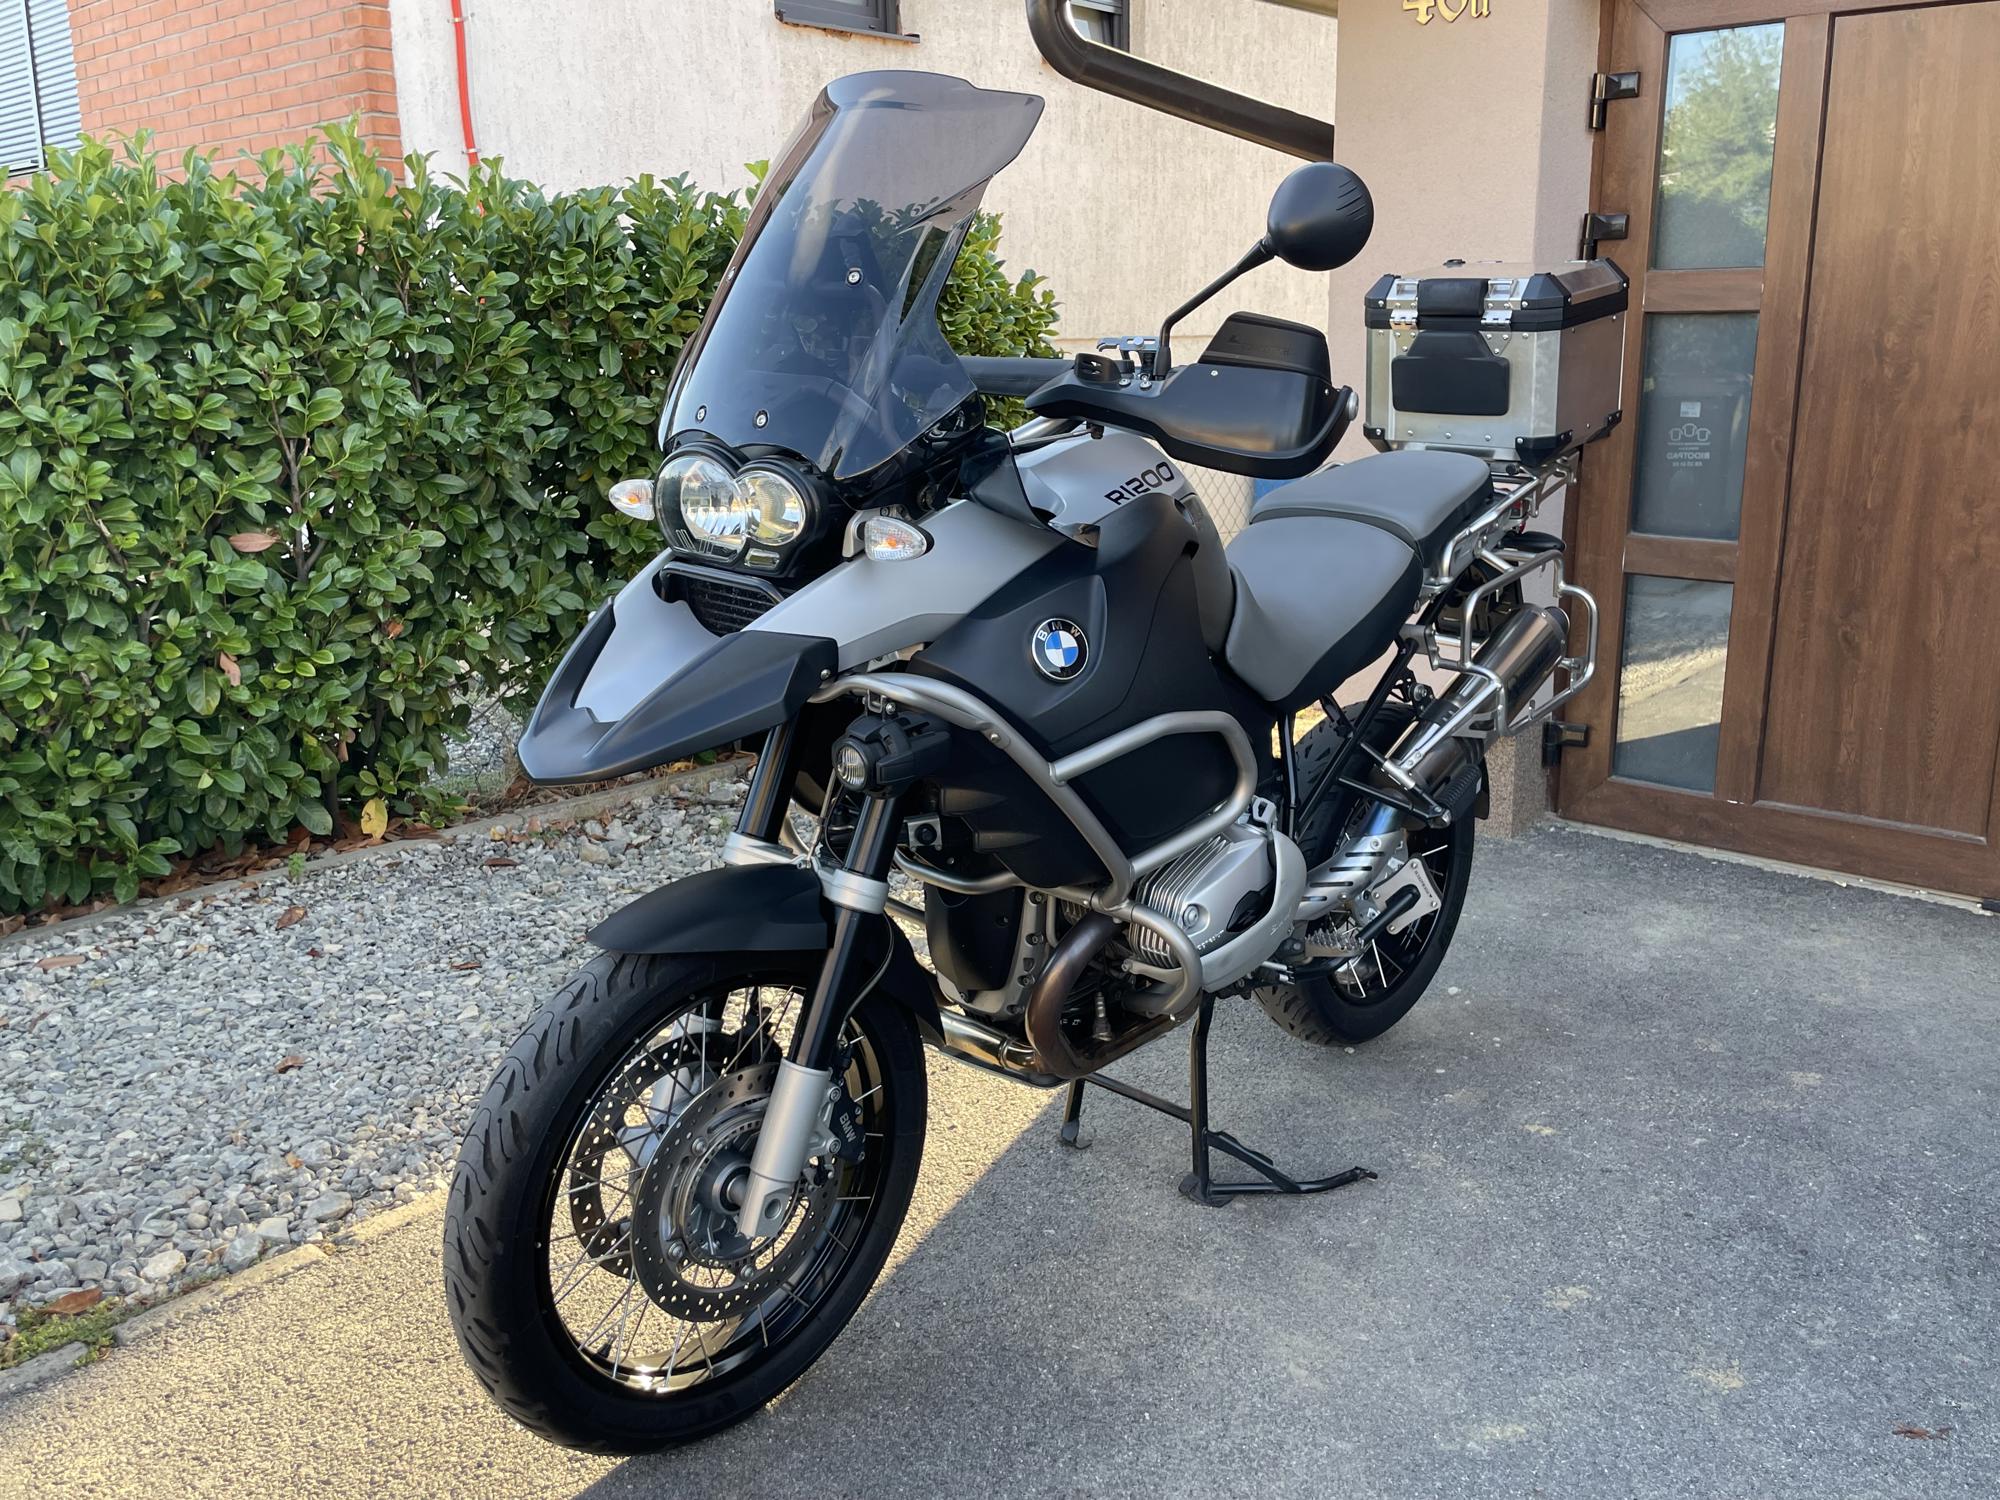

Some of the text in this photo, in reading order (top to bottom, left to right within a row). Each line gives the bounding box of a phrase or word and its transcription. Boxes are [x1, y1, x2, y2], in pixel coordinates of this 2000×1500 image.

[1104, 461, 1175, 506] R1200
[1037, 621, 1081, 641] BMW
[839, 1112, 857, 1143] BMW
